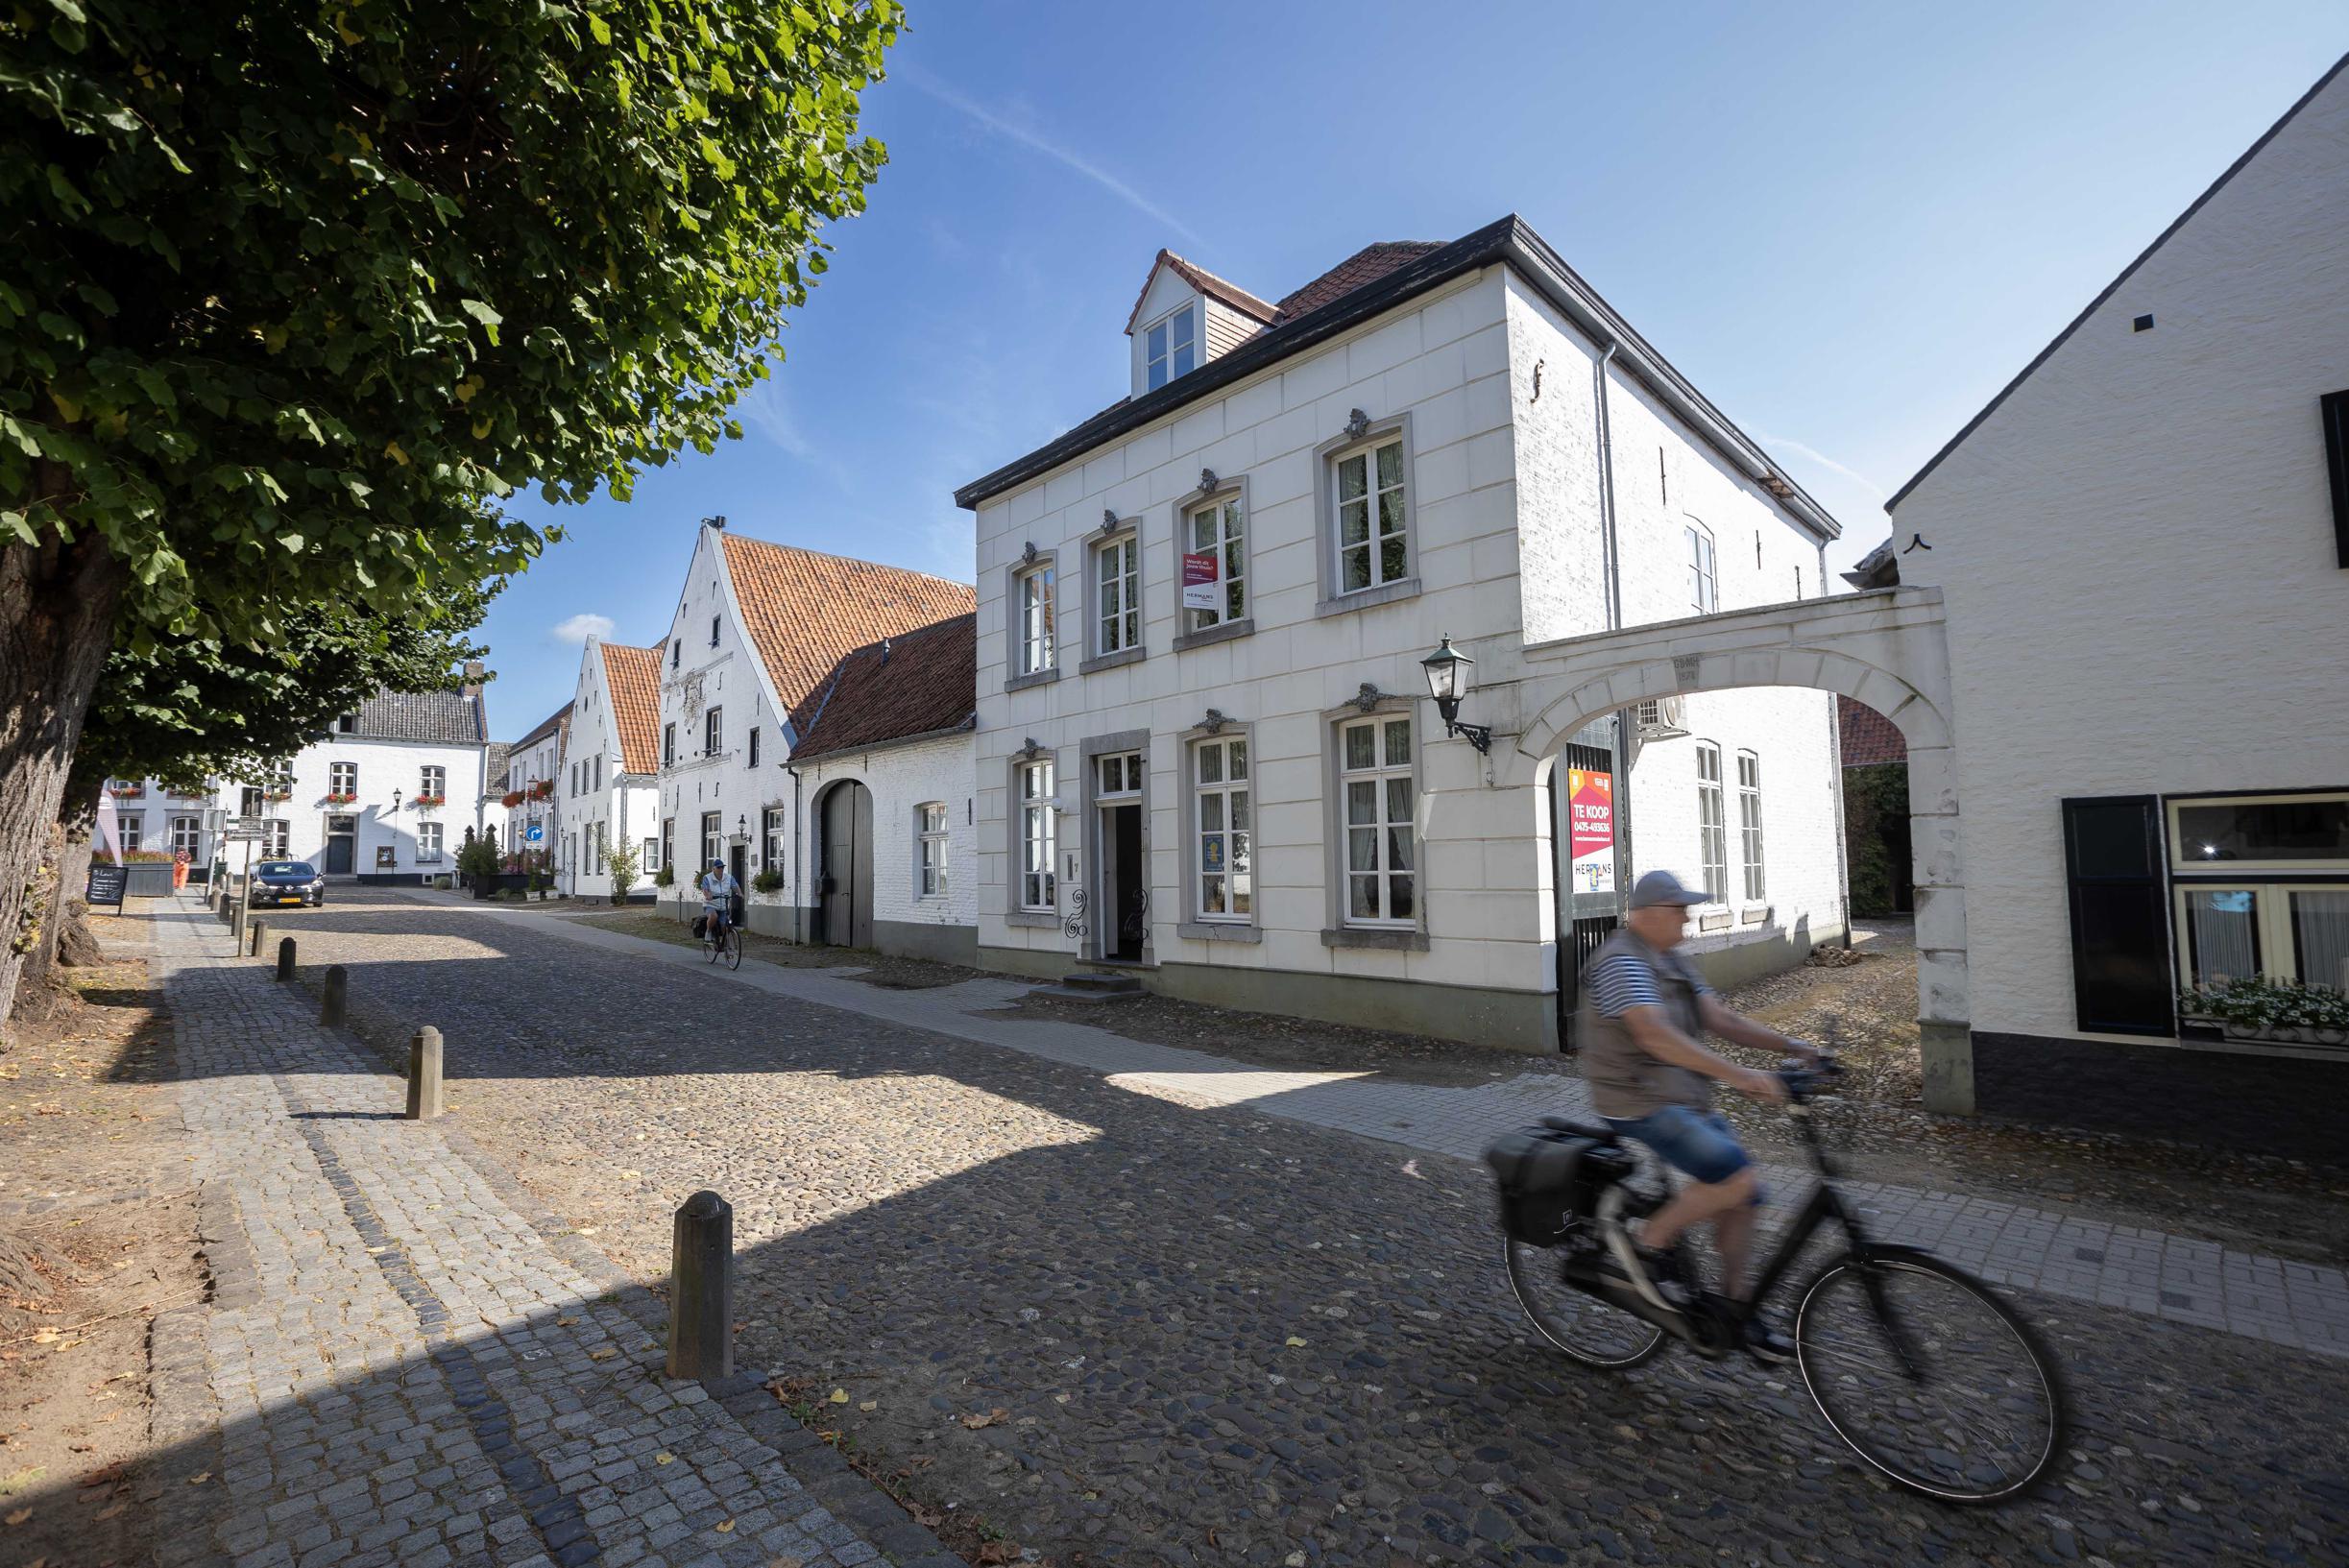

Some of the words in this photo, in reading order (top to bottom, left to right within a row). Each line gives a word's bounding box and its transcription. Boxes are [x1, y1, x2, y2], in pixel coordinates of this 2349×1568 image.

[1574, 805, 1585, 818] TE
[1586, 805, 1610, 819] KOOP
[1576, 864, 1611, 876] HERANS
